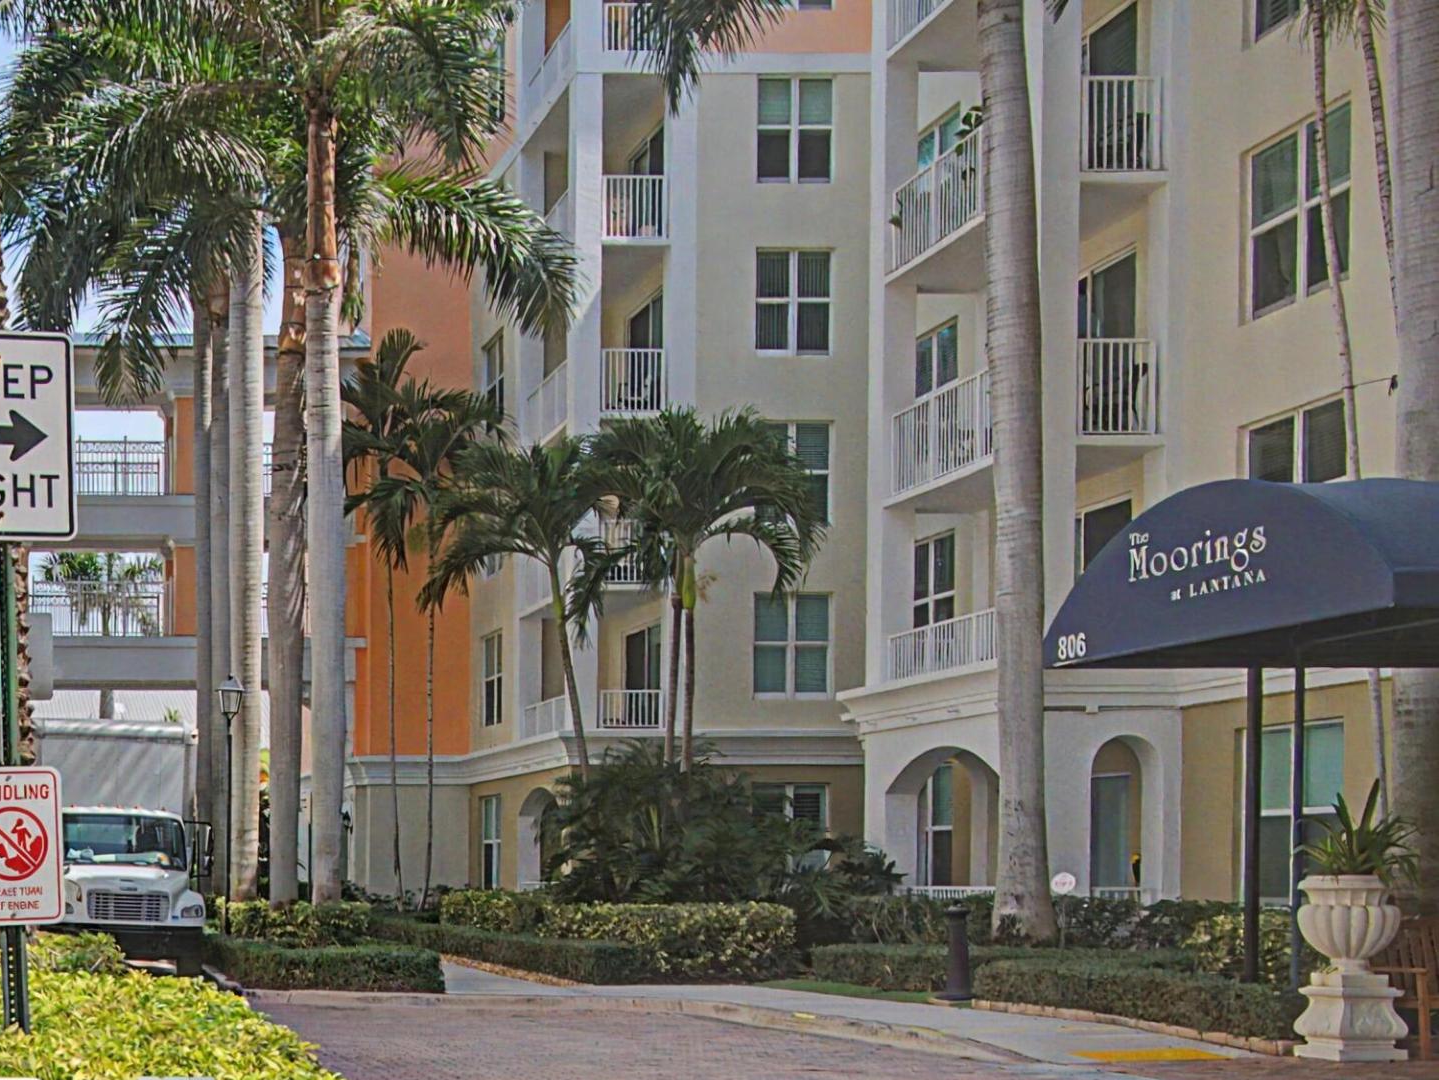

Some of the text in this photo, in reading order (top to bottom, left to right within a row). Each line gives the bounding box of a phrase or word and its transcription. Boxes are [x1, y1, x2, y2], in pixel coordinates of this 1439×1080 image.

[1128, 532, 1149, 546] The
[1128, 526, 1267, 582] Moorings
[1189, 568, 1267, 598] LANTANA
[1057, 632, 1087, 660] 806
[8, 900, 40, 910] ENGINE
